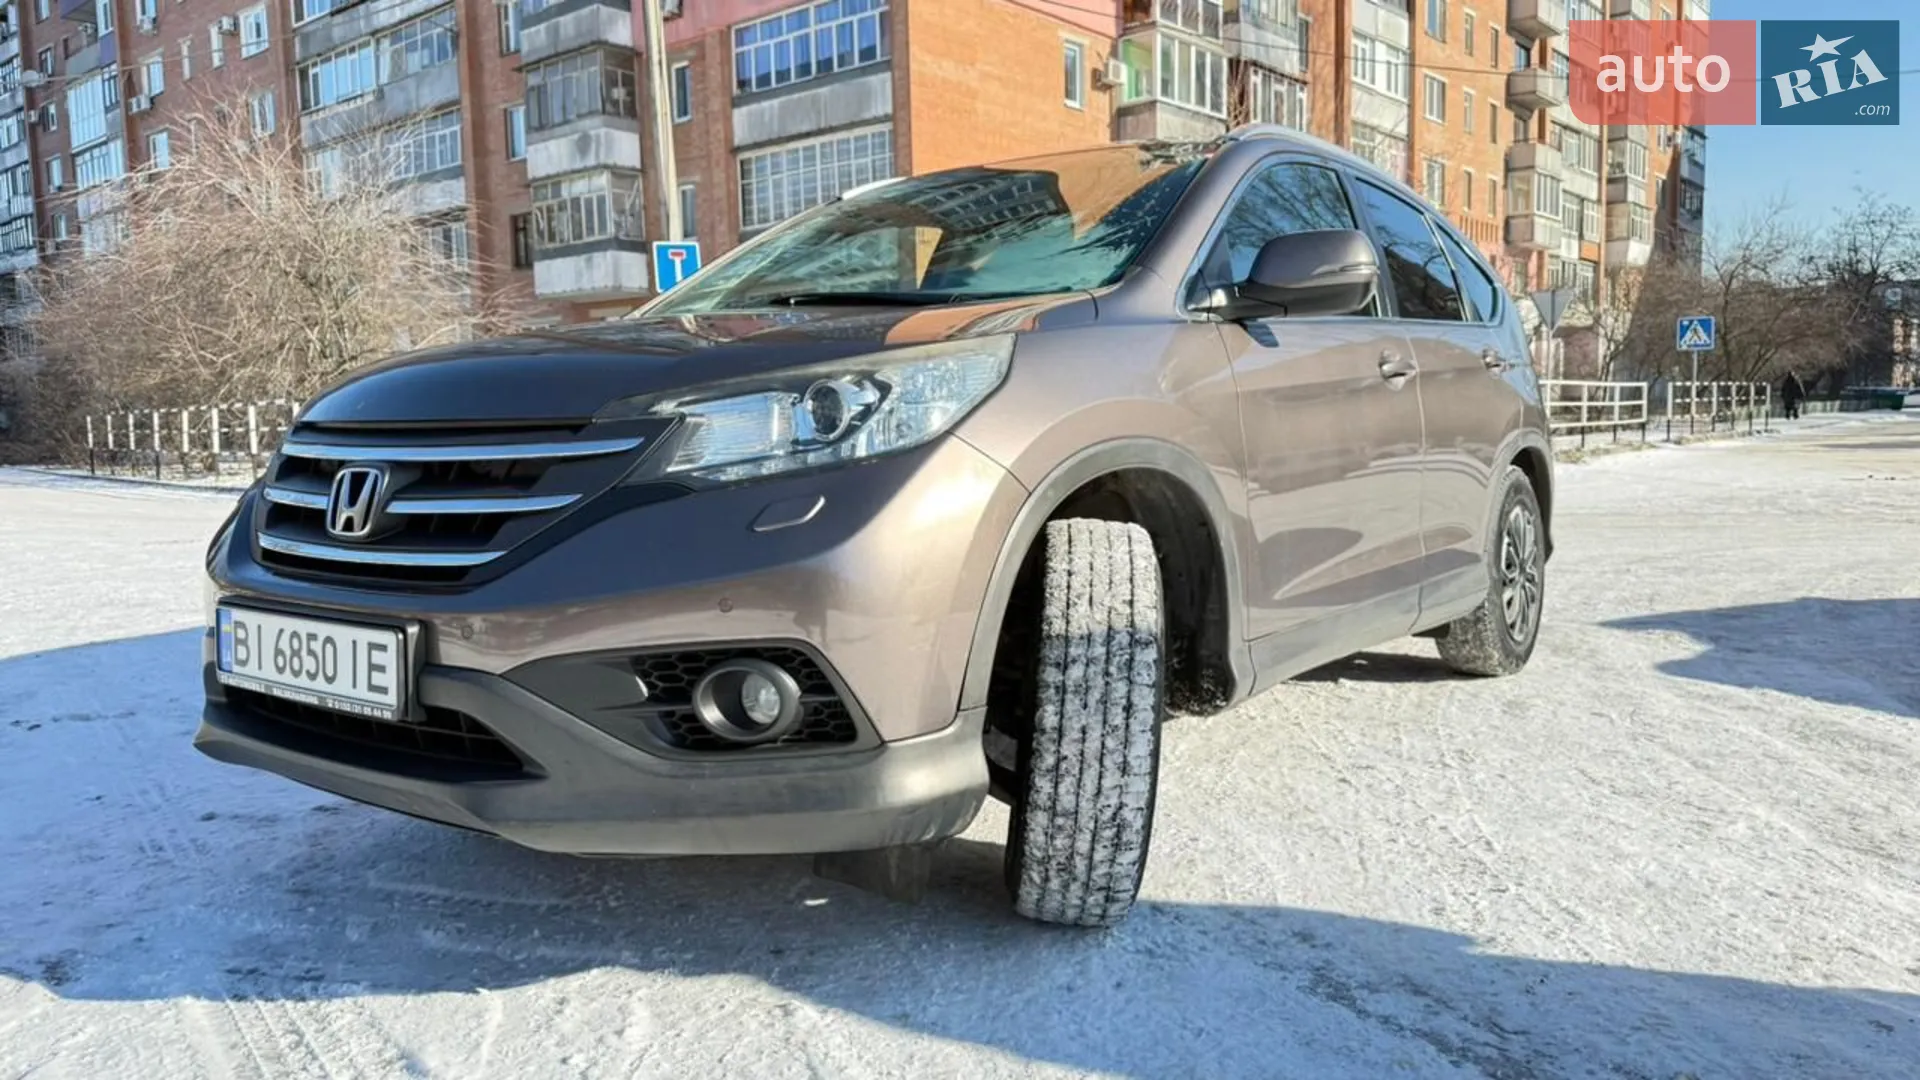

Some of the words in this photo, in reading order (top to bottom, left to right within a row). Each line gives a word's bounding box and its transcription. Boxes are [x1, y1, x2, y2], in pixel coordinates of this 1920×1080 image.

[233, 620, 263, 672] BI
[273, 627, 338, 685] 6850
[351, 639, 389, 696] IE
